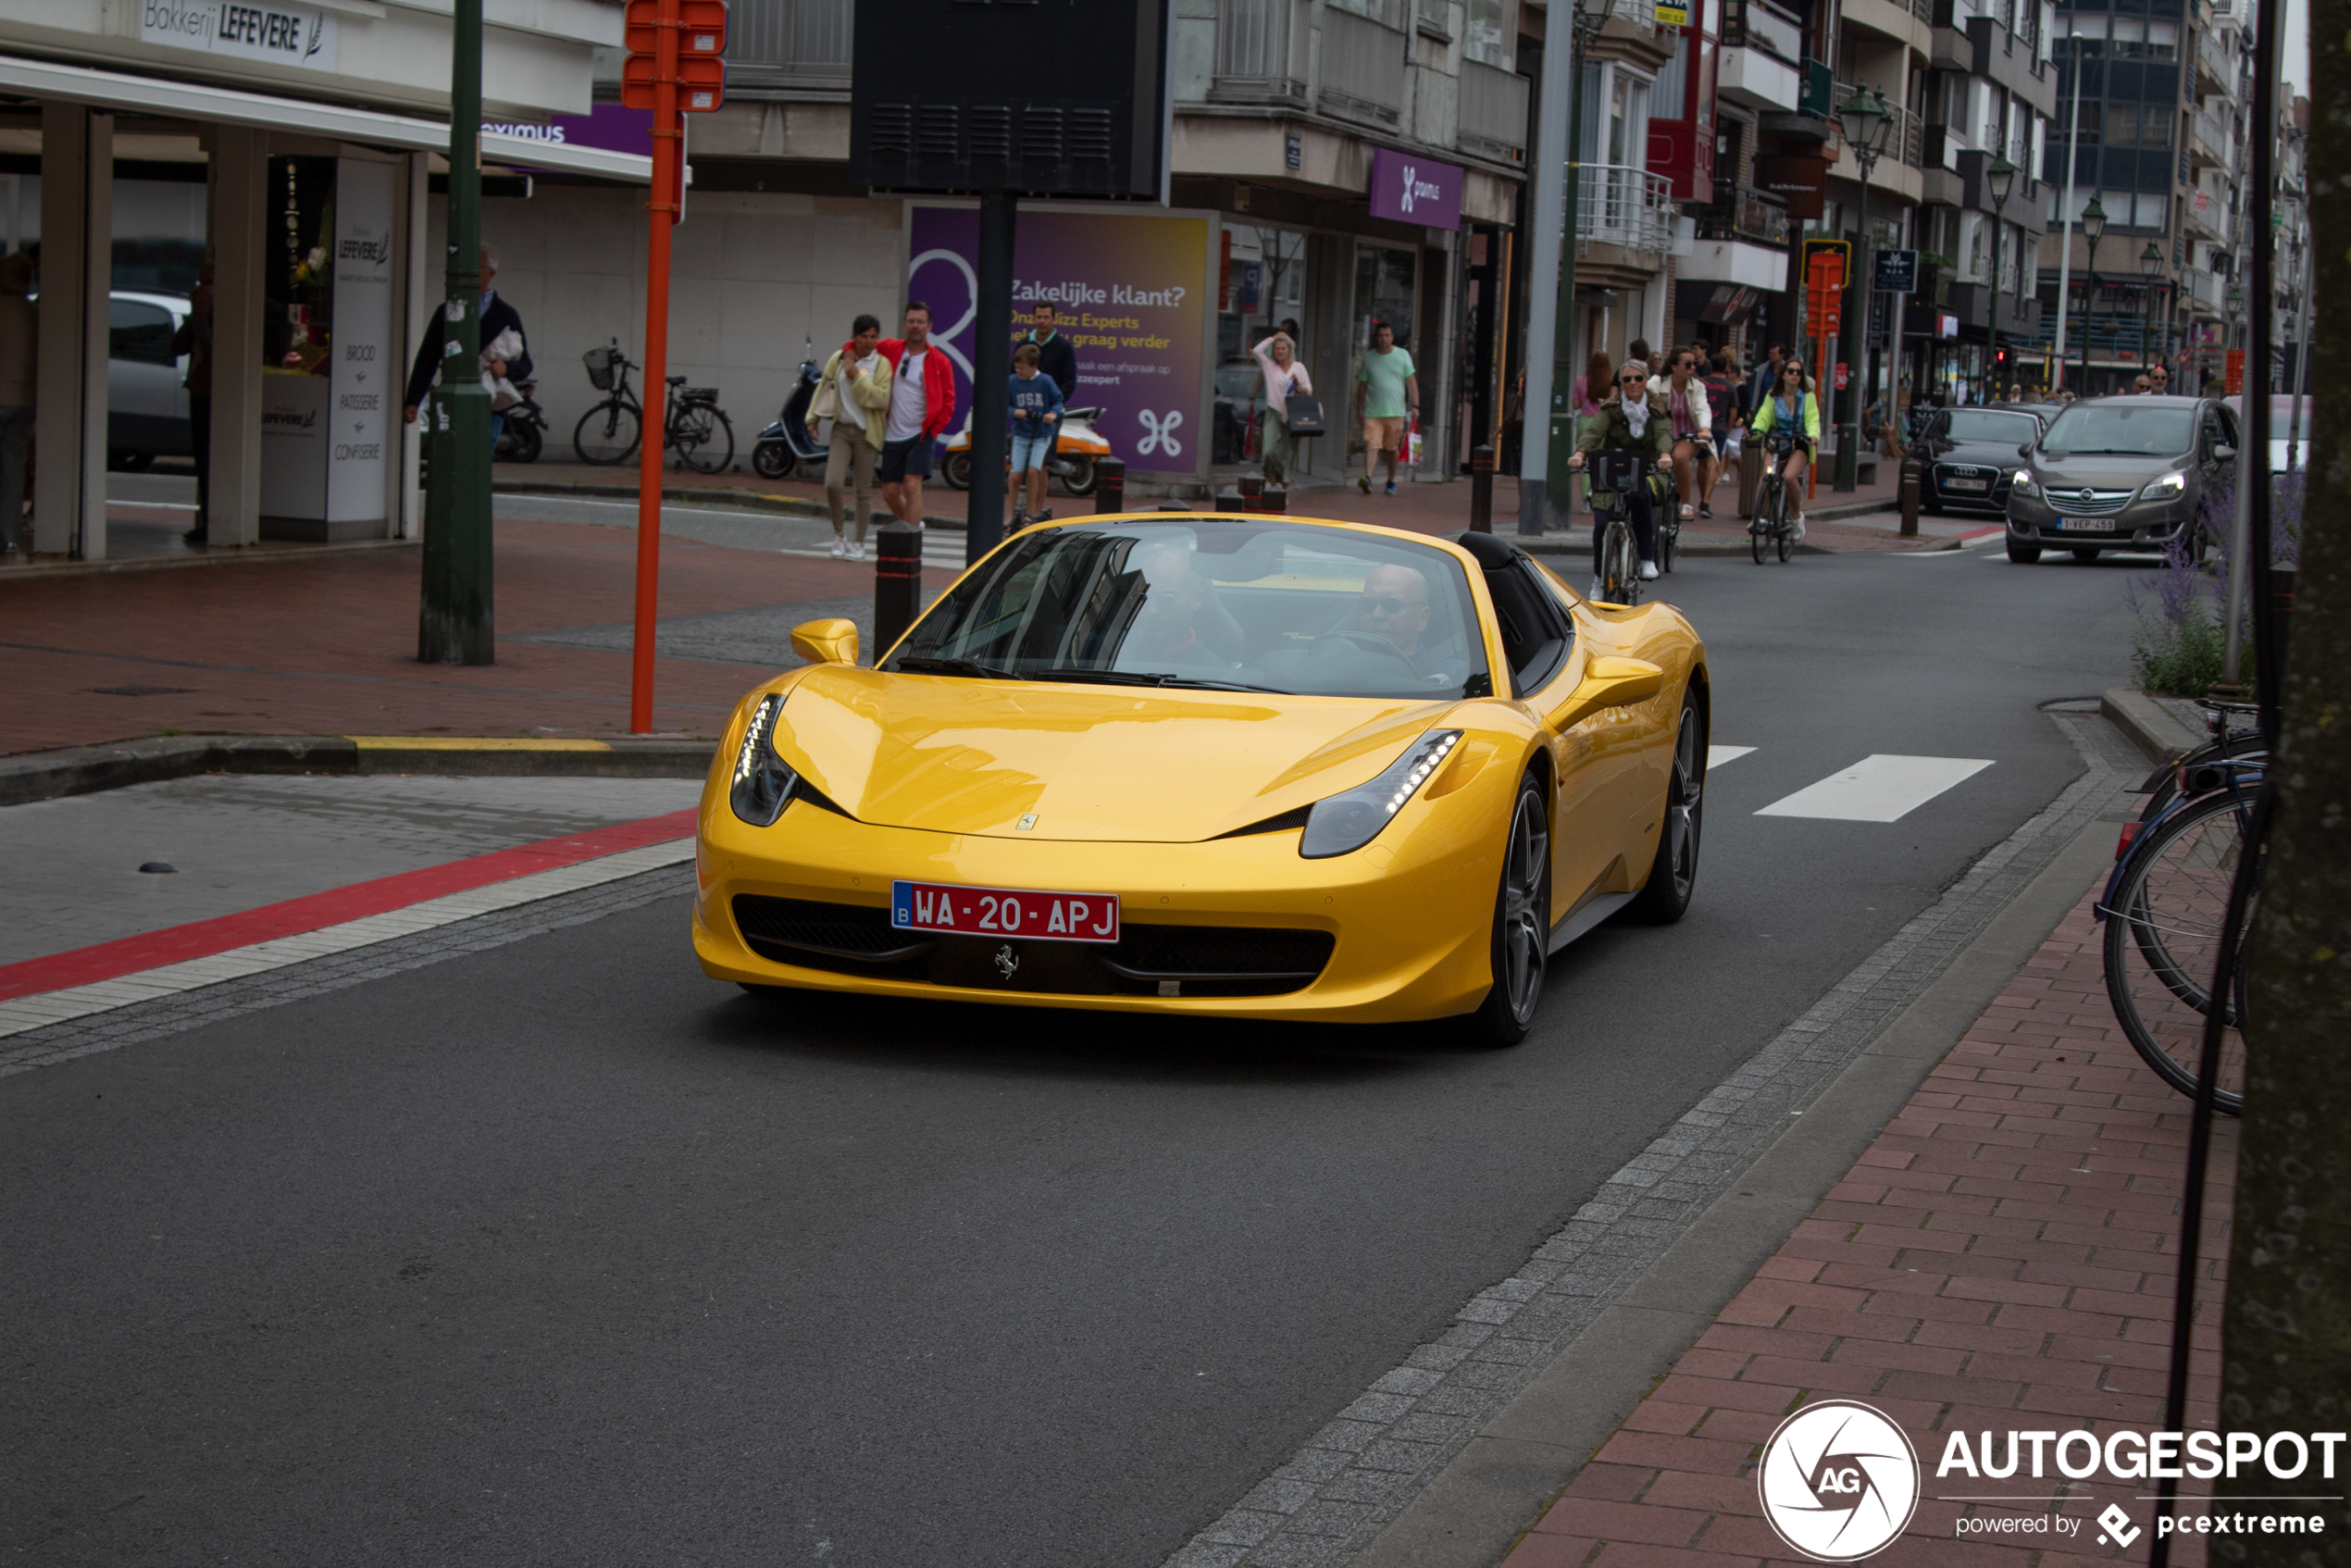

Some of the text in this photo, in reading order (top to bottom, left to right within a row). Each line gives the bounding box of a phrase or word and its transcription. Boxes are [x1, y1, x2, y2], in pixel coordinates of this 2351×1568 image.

[145, 0, 301, 52] Bakkerij LEFEVERE
[339, 240, 378, 260] LEFEVERE
[1012, 280, 1186, 307] Zakelijke klant?
[1011, 309, 1035, 325] Onz
[1081, 313, 1139, 330] Experts
[1073, 334, 1117, 349] graag
[1121, 334, 1170, 349] verder
[346, 344, 377, 361] BROOD
[1116, 361, 1156, 374] afspraak
[340, 394, 379, 411] PATISSERIE
[1016, 392, 1045, 407] USA
[334, 443, 381, 460] CONFISERIE
[2064, 519, 2113, 529] 1-VEP-459
[898, 907, 910, 924] B
